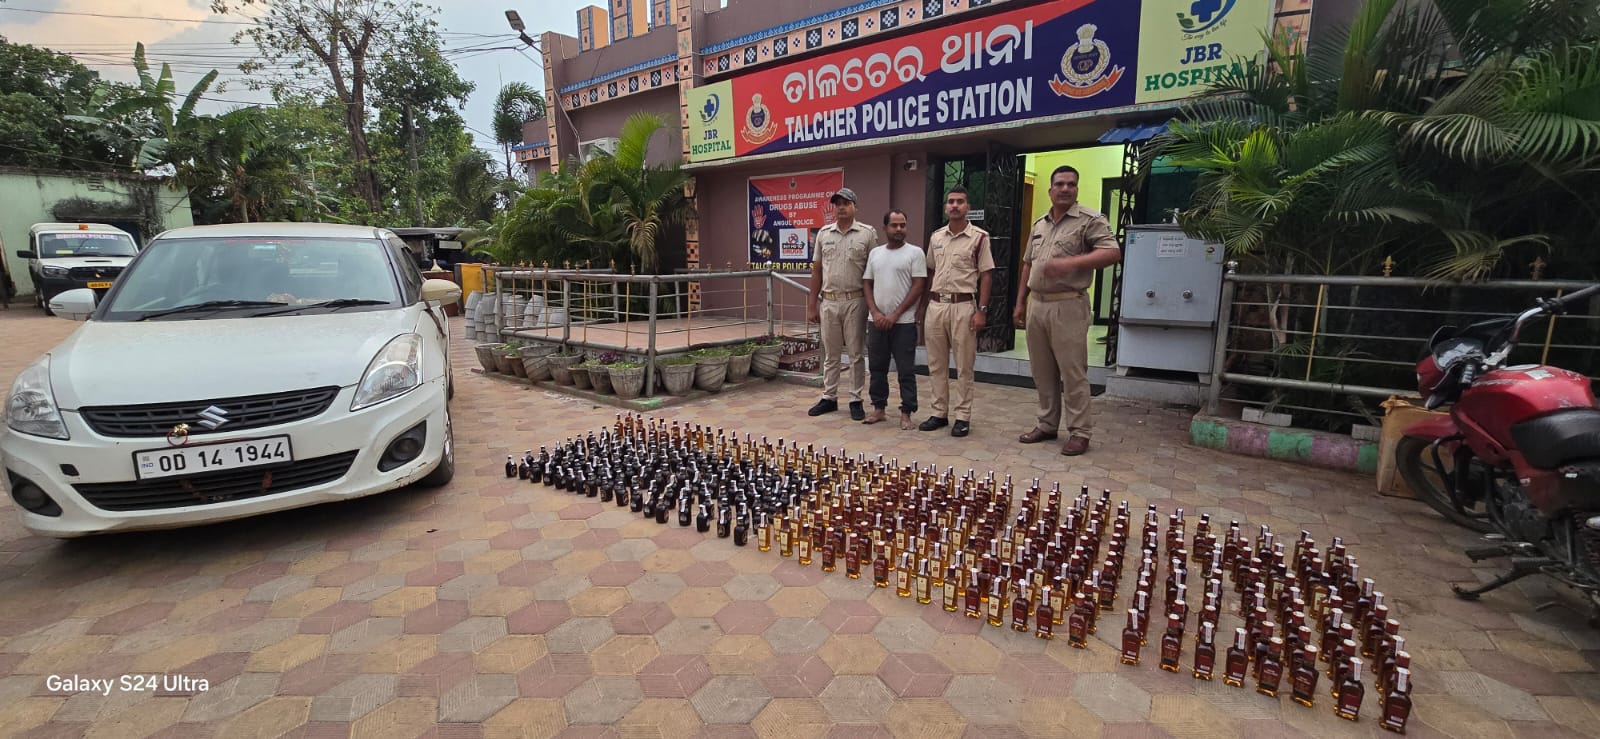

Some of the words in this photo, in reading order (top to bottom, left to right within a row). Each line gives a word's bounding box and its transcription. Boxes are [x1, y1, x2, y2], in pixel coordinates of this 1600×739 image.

[1180, 42, 1223, 65] JBR
[783, 45, 927, 104] ତାଳଚେର
[940, 19, 1034, 74] ଥାନା
[785, 106, 858, 144] TALCHER
[862, 93, 930, 134] POLICE
[936, 76, 1033, 124] STATION
[703, 129, 718, 141] JBR
[691, 140, 732, 155] HOSPITAL
[788, 192, 825, 200] PROGRAMME
[769, 203, 793, 211] DRUGS
[794, 201, 818, 210] ABUSE
[782, 262, 806, 270] POLICE
[159, 453, 186, 472] OD
[198, 449, 223, 468] 14
[235, 442, 285, 463] 1944
